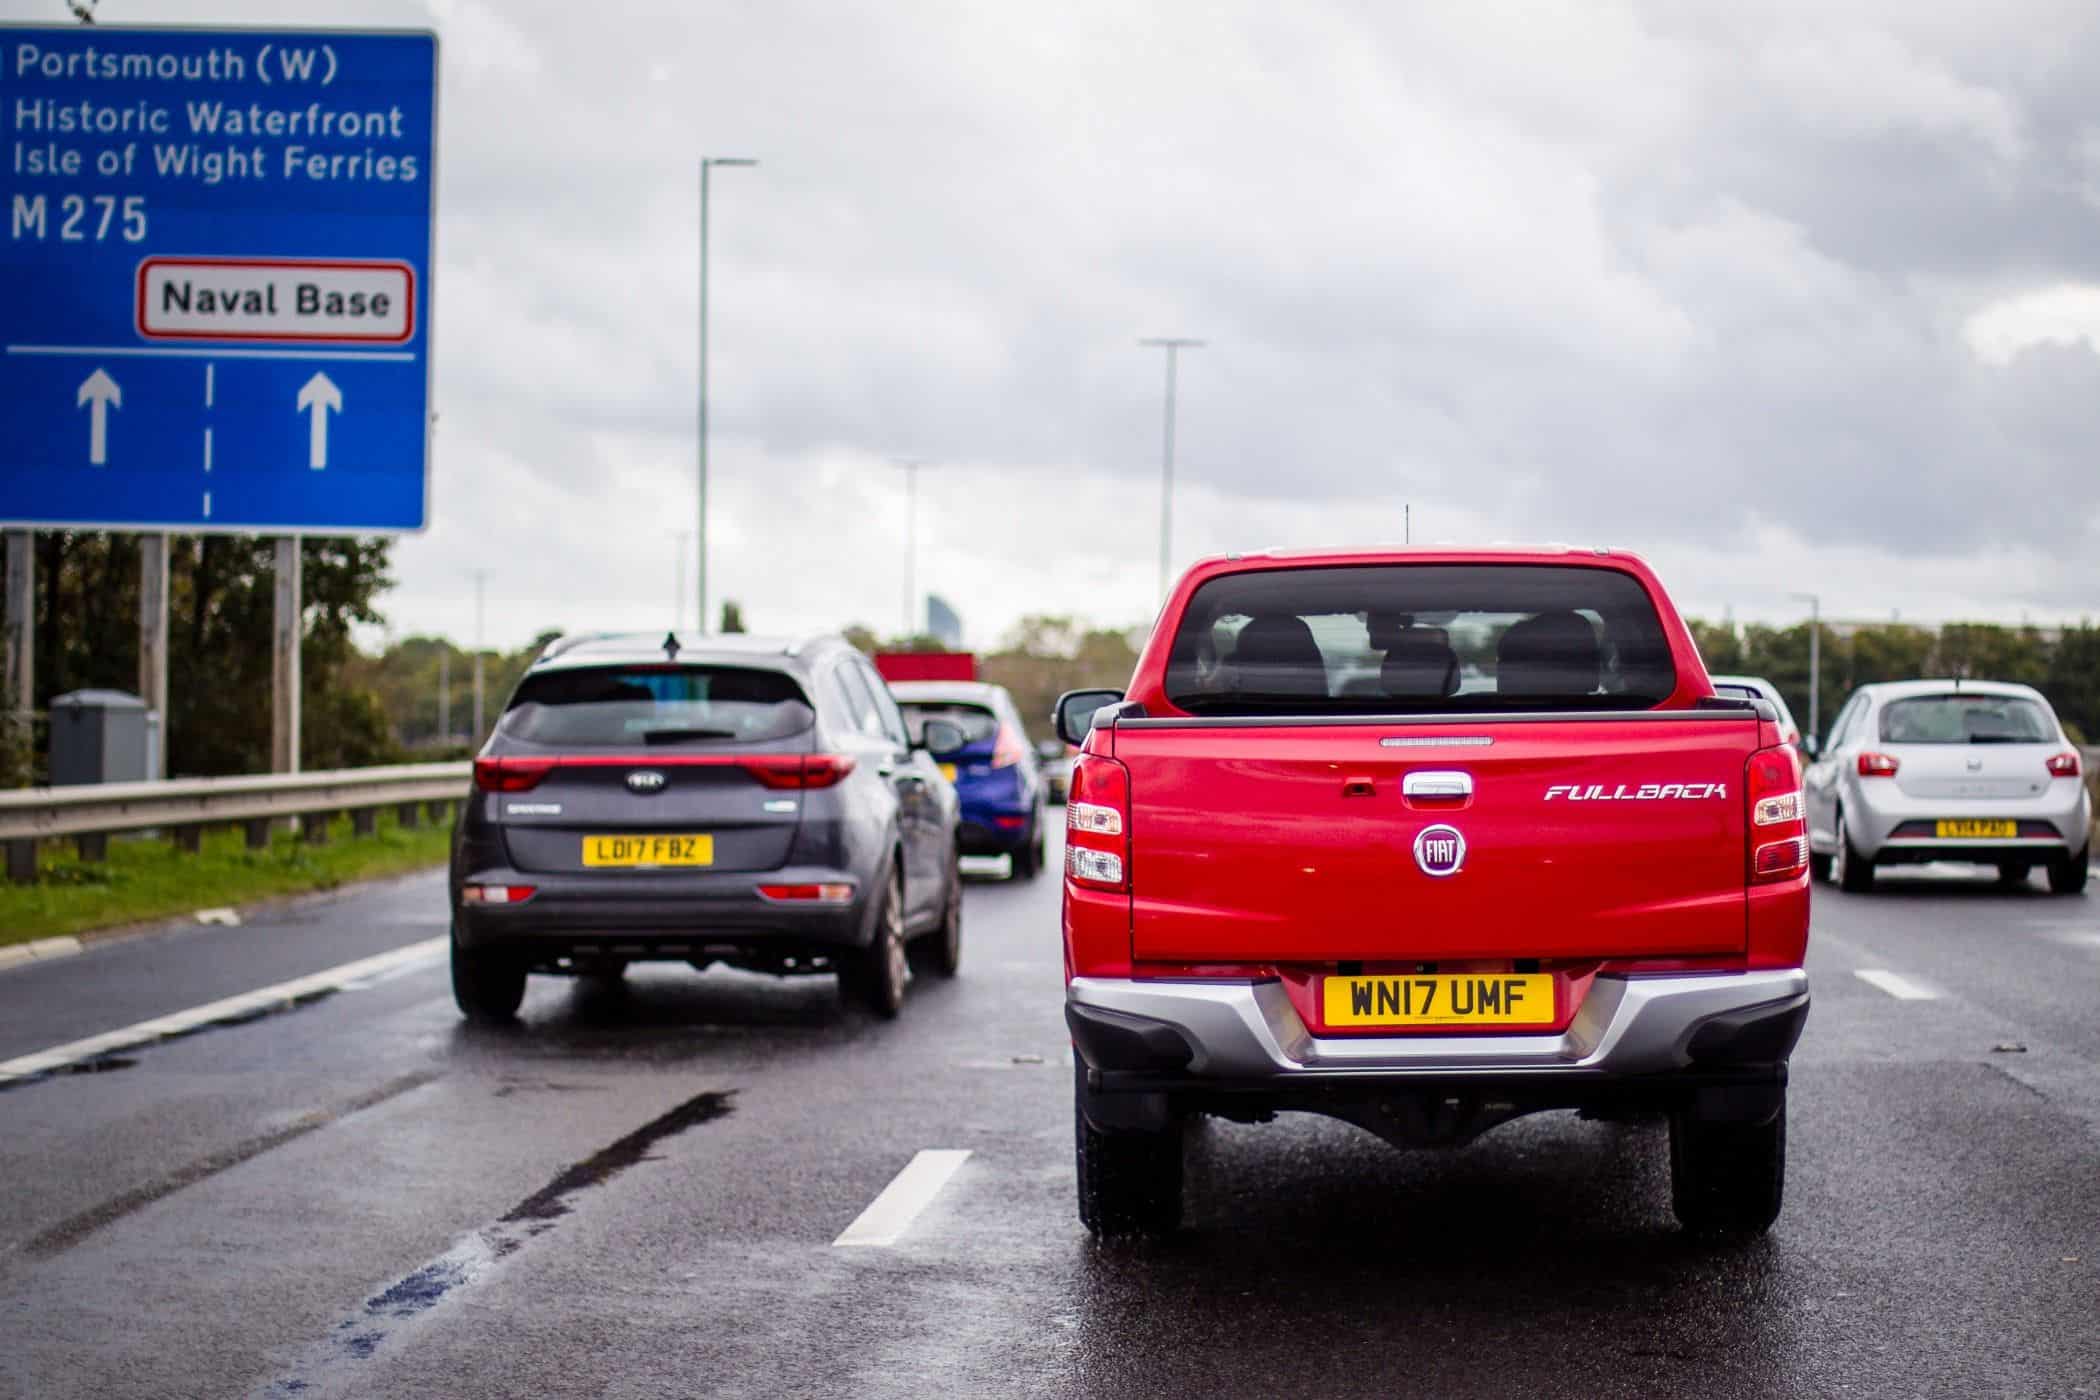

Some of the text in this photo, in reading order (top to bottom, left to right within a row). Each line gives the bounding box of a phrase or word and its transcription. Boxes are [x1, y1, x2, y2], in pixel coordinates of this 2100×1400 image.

[16, 44, 337, 86] Portsmouth (W)
[15, 100, 403, 137] Historic Waterfront
[14, 142, 418, 184] Isle of Wight Ferries
[163, 280, 390, 317] Naval Base
[1544, 783, 1727, 801] FULLBACK
[653, 838, 697, 859] FBZ
[1426, 840, 1455, 863] FIAT
[1351, 980, 1527, 1016] WN17 UMF
